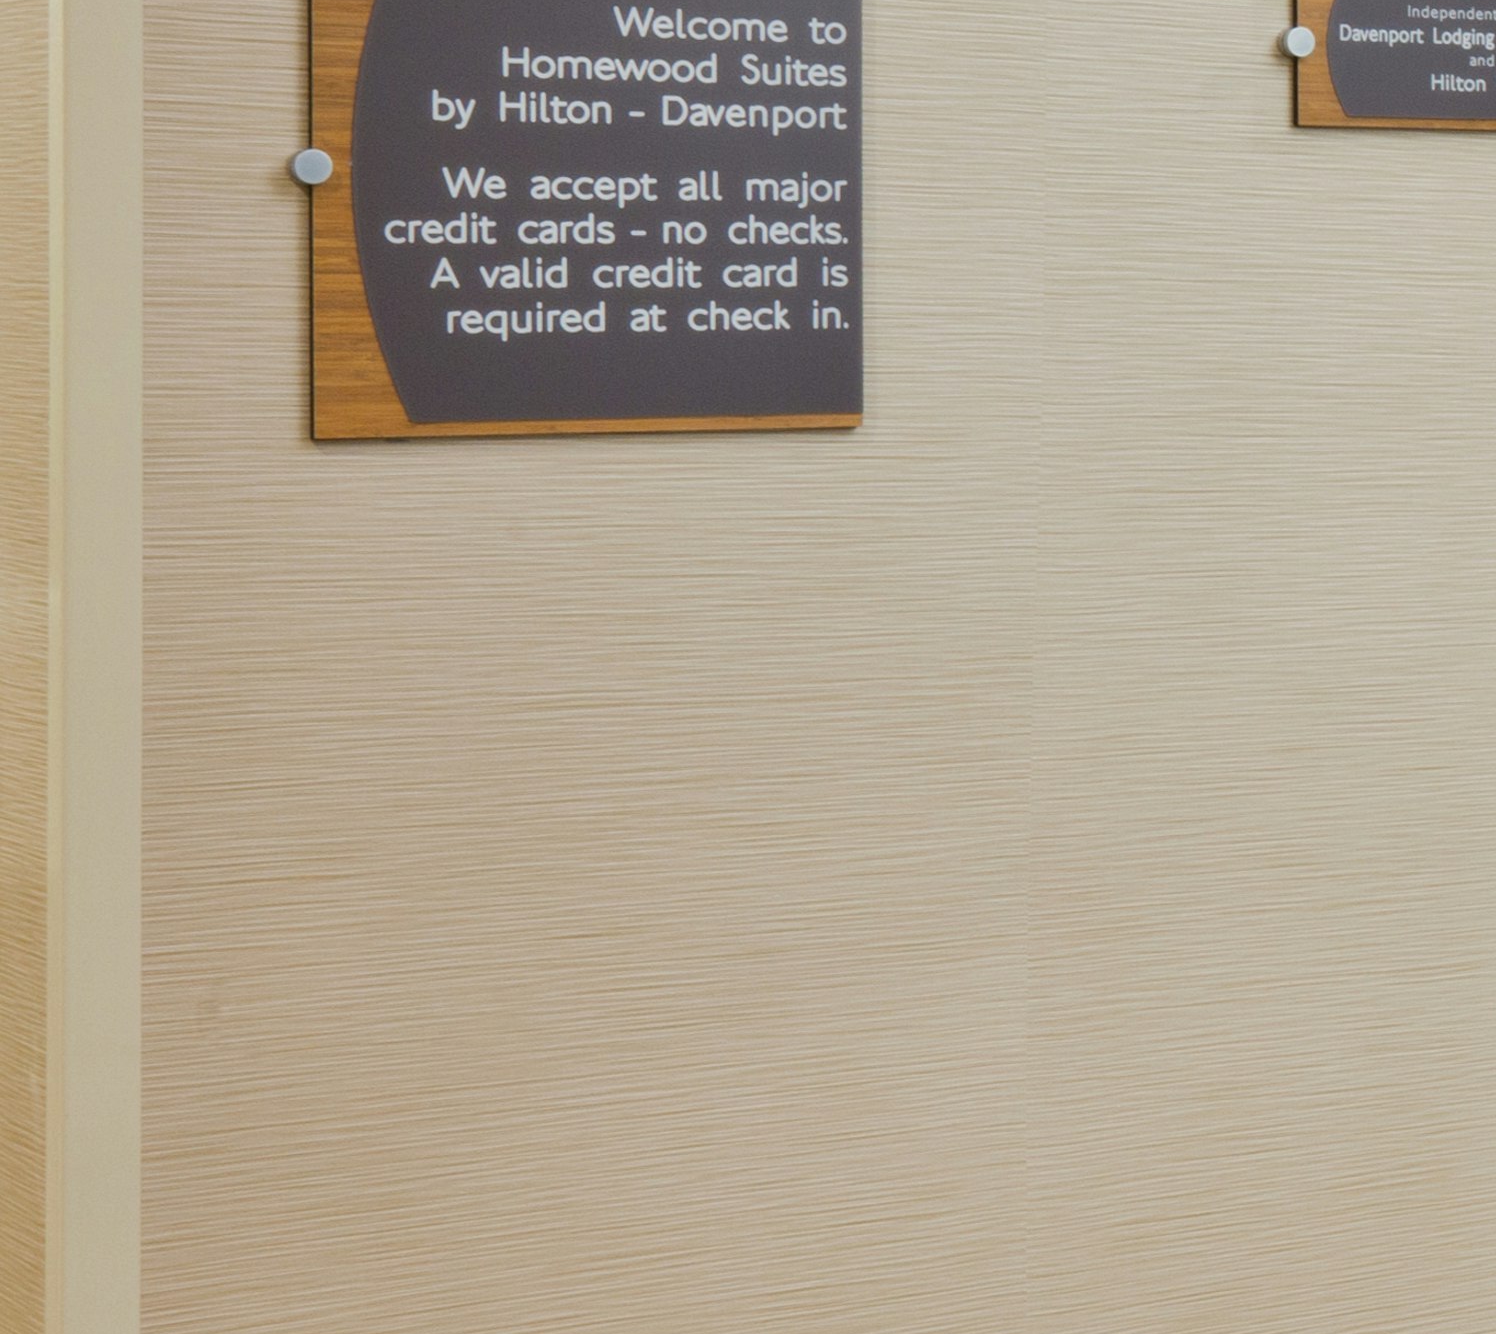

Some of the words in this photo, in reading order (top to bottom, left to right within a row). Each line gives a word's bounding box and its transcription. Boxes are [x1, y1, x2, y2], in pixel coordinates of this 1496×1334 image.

[613, 5, 788, 42] Welcome
[809, 17, 847, 44] to
[1339, 23, 1424, 46] Davenport
[1432, 27, 1495, 50] Lodging
[501, 46, 718, 84] Homewood
[741, 54, 847, 86] Suites
[1469, 55, 1495, 67] and
[1430, 74, 1487, 92] Hilton
[432, 89, 475, 129] by
[500, 91, 612, 124] Hilton
[662, 95, 847, 135] Davenport
[443, 166, 507, 200] We
[530, 171, 657, 208] accept
[678, 171, 722, 201] all
[745, 175, 847, 208] major
[384, 212, 497, 245] credit
[517, 213, 616, 245] cards
[662, 221, 707, 244] no
[727, 215, 849, 245] checks.
[430, 257, 459, 289] A
[480, 257, 568, 288] valid
[592, 257, 702, 288] credit
[722, 257, 798, 287] card
[821, 257, 848, 286] is
[446, 301, 605, 342] required
[629, 305, 666, 332] at
[687, 300, 790, 331] check
[812, 300, 849, 329] in.
